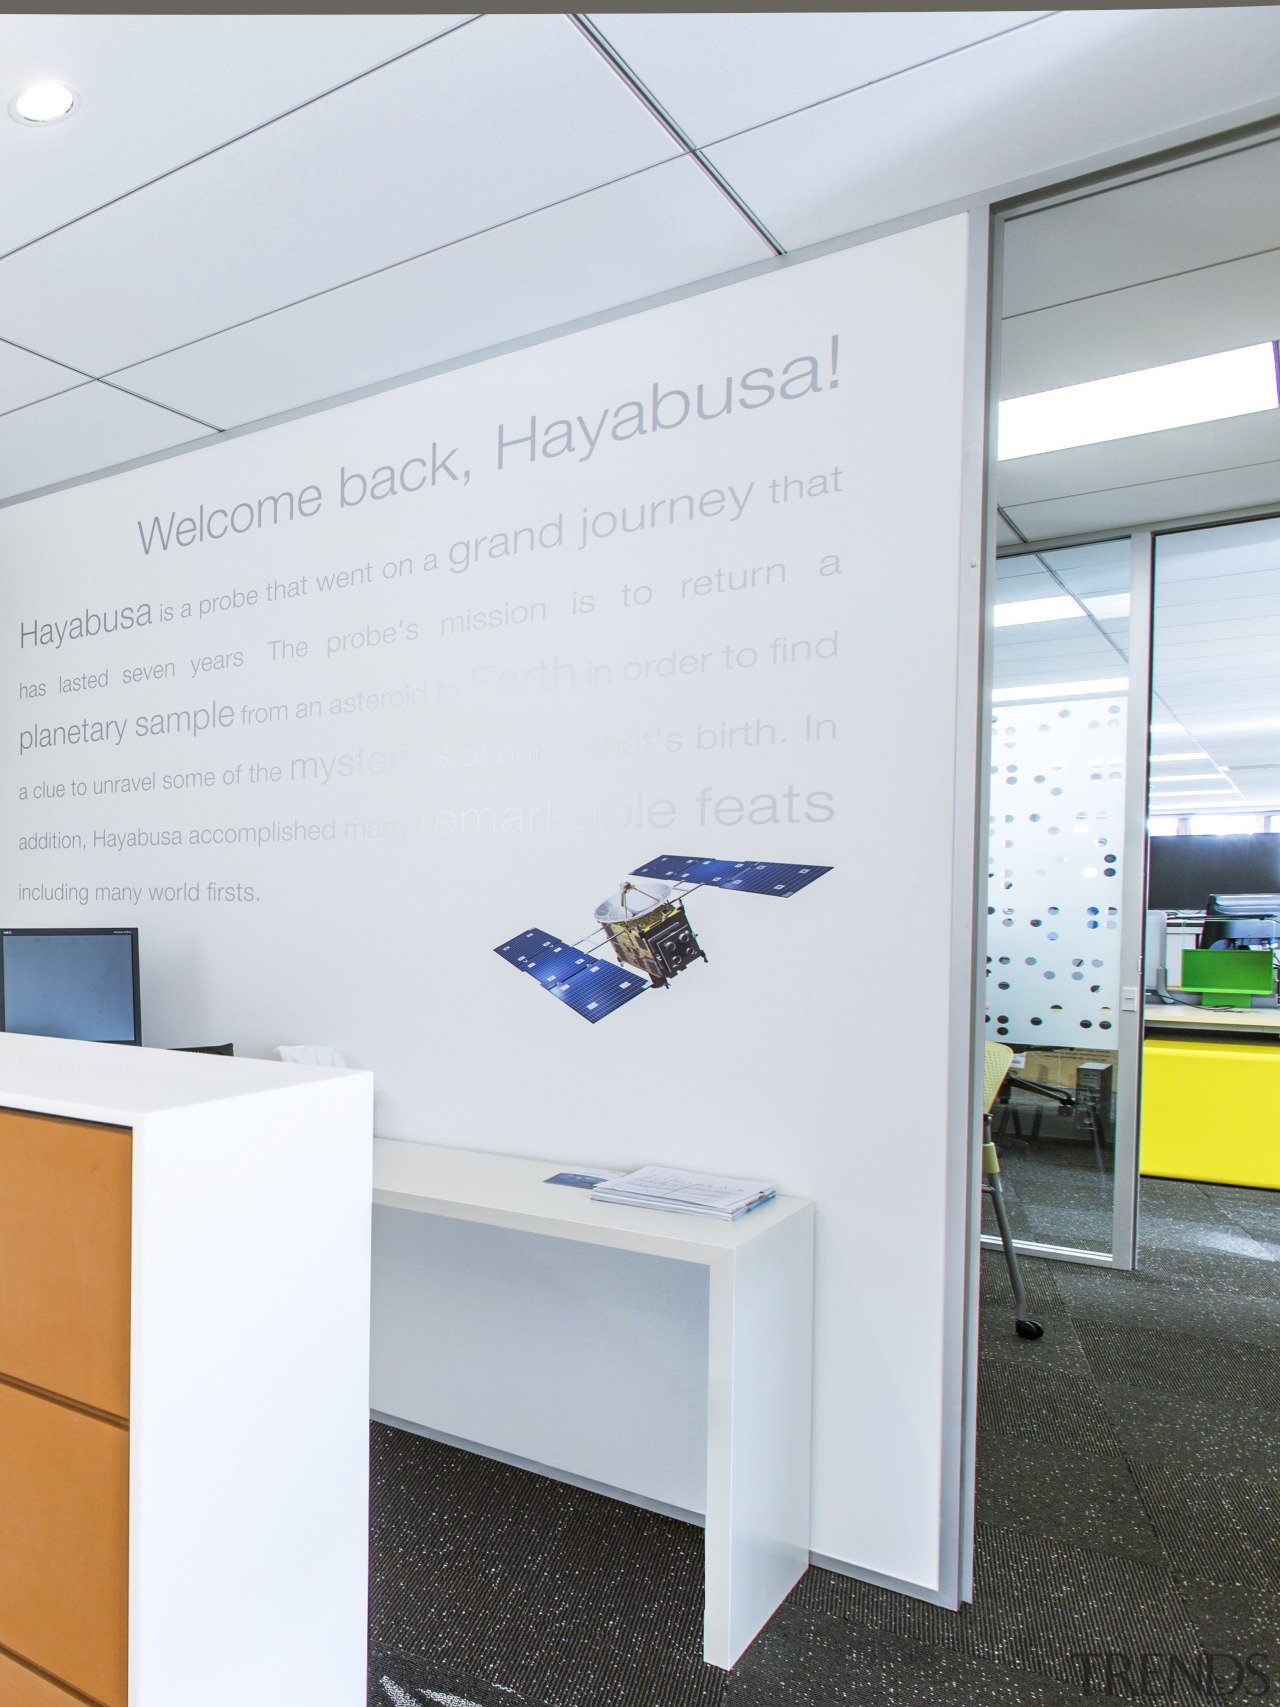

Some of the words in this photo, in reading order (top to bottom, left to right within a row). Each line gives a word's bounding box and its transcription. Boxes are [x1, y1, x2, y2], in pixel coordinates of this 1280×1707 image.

[137, 485, 323, 556] Welcome
[340, 442, 471, 508] back,
[497, 334, 839, 470] Hayabusa!
[20, 603, 153, 650] Hayabusa
[159, 603, 174, 622] is
[180, 602, 192, 619] a
[199, 588, 258, 620] probe
[266, 576, 308, 602] that
[316, 562, 373, 592] went
[382, 558, 413, 579] on
[423, 553, 438, 571] a
[449, 512, 563, 574] grand
[578, 481, 755, 551] journey
[768, 466, 843, 504] that
[19, 682, 47, 700] has
[59, 668, 109, 694] lasted
[122, 662, 175, 684] seven
[190, 651, 244, 678] years
[267, 639, 308, 661] The
[327, 620, 419, 658] probe's
[441, 602, 546, 635] mission
[573, 591, 595, 615] is
[621, 584, 653, 607] to
[682, 563, 786, 598] return
[819, 555, 842, 577] a
[19, 718, 128, 756] planetary
[135, 700, 235, 737] sample
[241, 704, 288, 725] from
[296, 701, 322, 719] an
[329, 681, 427, 715] asteroid
[471, 656, 576, 697] Earth
[587, 660, 611, 687] in
[622, 651, 713, 681] order
[723, 645, 758, 669] to
[770, 630, 838, 664] find
[18, 786, 28, 801] a
[33, 781, 66, 799] clue
[70, 779, 87, 797] to
[93, 772, 156, 795] unravel
[162, 771, 215, 790] some
[222, 764, 242, 785] of
[249, 763, 282, 783] the
[290, 741, 450, 785] mysteries
[697, 719, 786, 749] birth.
[806, 715, 836, 741] In
[18, 831, 86, 851] addition,
[93, 827, 183, 852] Hayabusa
[188, 819, 335, 847] accomplished
[345, 819, 411, 843] many
[696, 785, 835, 826] feats
[19, 883, 89, 906] including
[95, 886, 142, 906] many
[148, 882, 200, 902] world
[206, 882, 260, 902] firsts.
